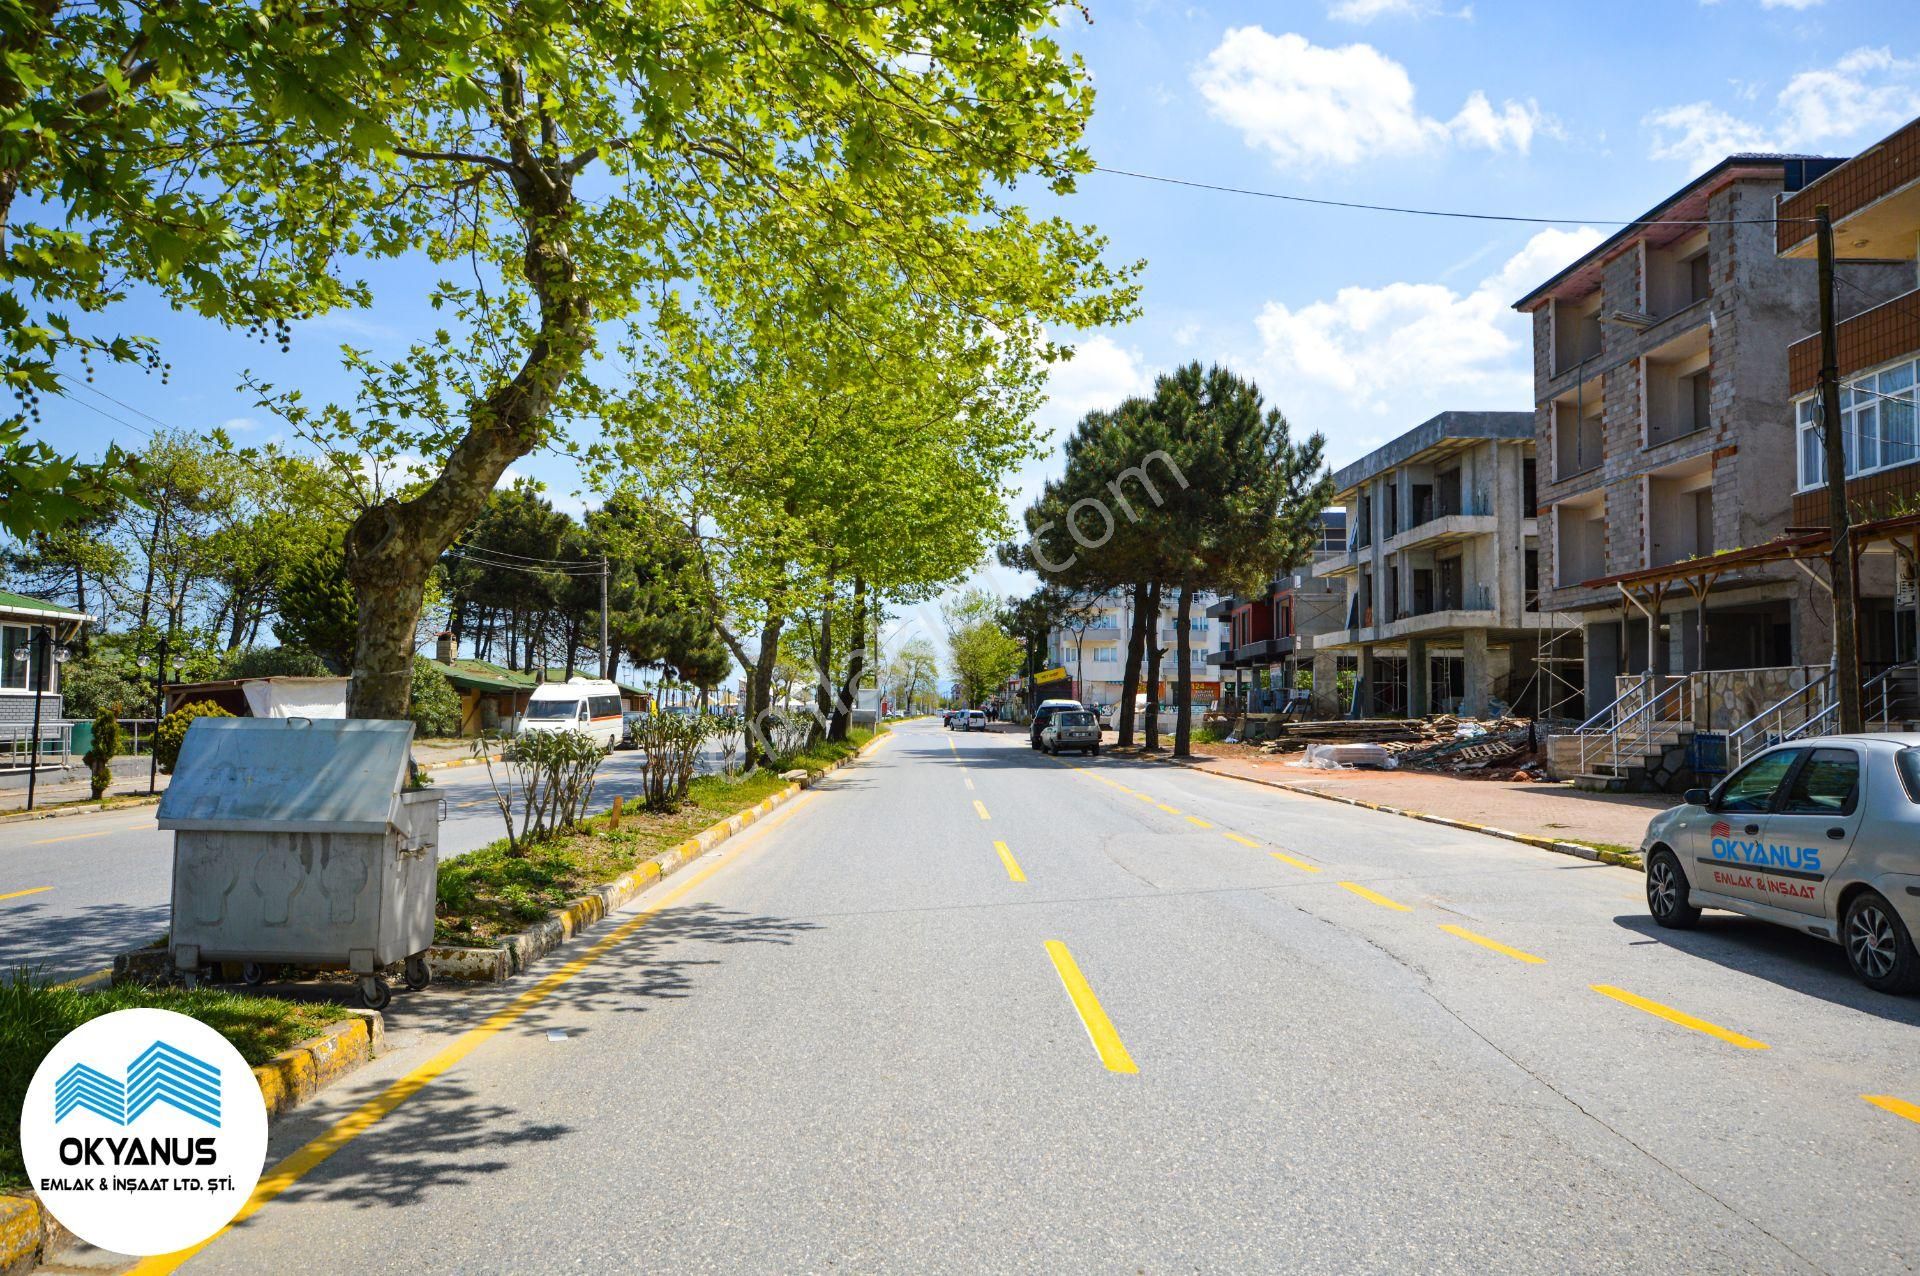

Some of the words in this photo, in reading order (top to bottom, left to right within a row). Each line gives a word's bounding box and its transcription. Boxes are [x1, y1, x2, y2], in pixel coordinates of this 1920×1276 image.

[1711, 838, 1822, 871] OKYANUS
[1714, 872, 1754, 889] EMLAK
[1757, 878, 1766, 891] &
[1767, 877, 1816, 900] İNŞAAT
